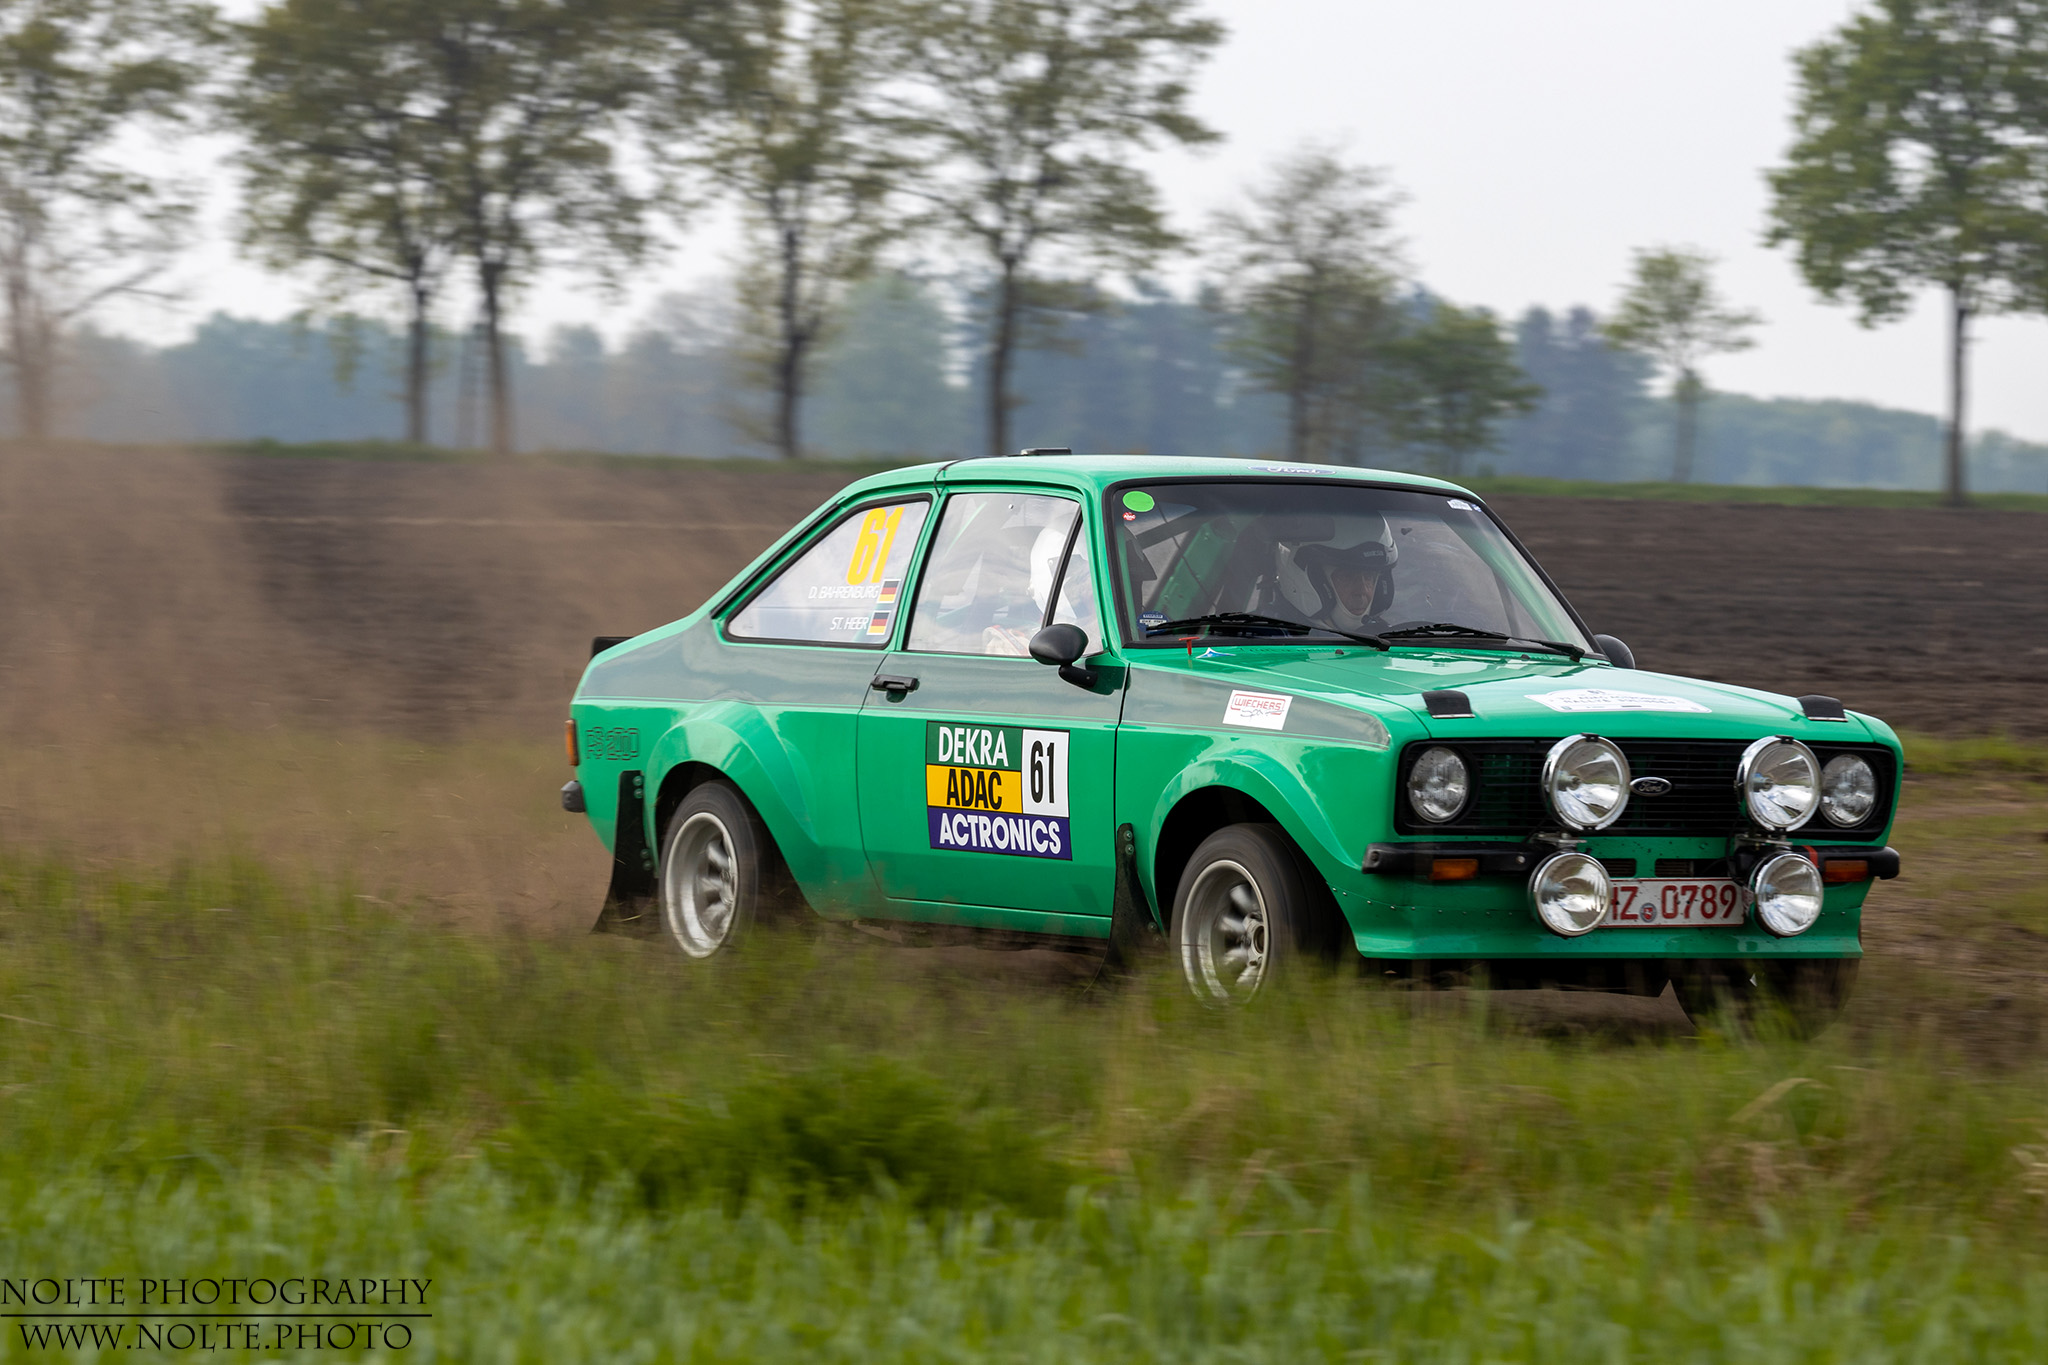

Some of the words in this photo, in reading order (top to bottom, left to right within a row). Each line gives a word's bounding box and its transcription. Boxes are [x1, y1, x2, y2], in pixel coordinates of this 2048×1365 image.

[847, 507, 905, 586] 61
[808, 586, 817, 599] D.
[819, 586, 880, 599] BAHRENBURG
[830, 617, 843, 630] ST.
[844, 617, 869, 630] HEER
[1234, 697, 1282, 711] WIECHERS
[938, 726, 1009, 767] DEKRA
[947, 768, 1003, 810] ADAC
[1030, 740, 1055, 804] 61
[1639, 780, 1664, 792] Ford
[939, 812, 1062, 855] ACTRONICS
[1661, 884, 1737, 919] 0789
